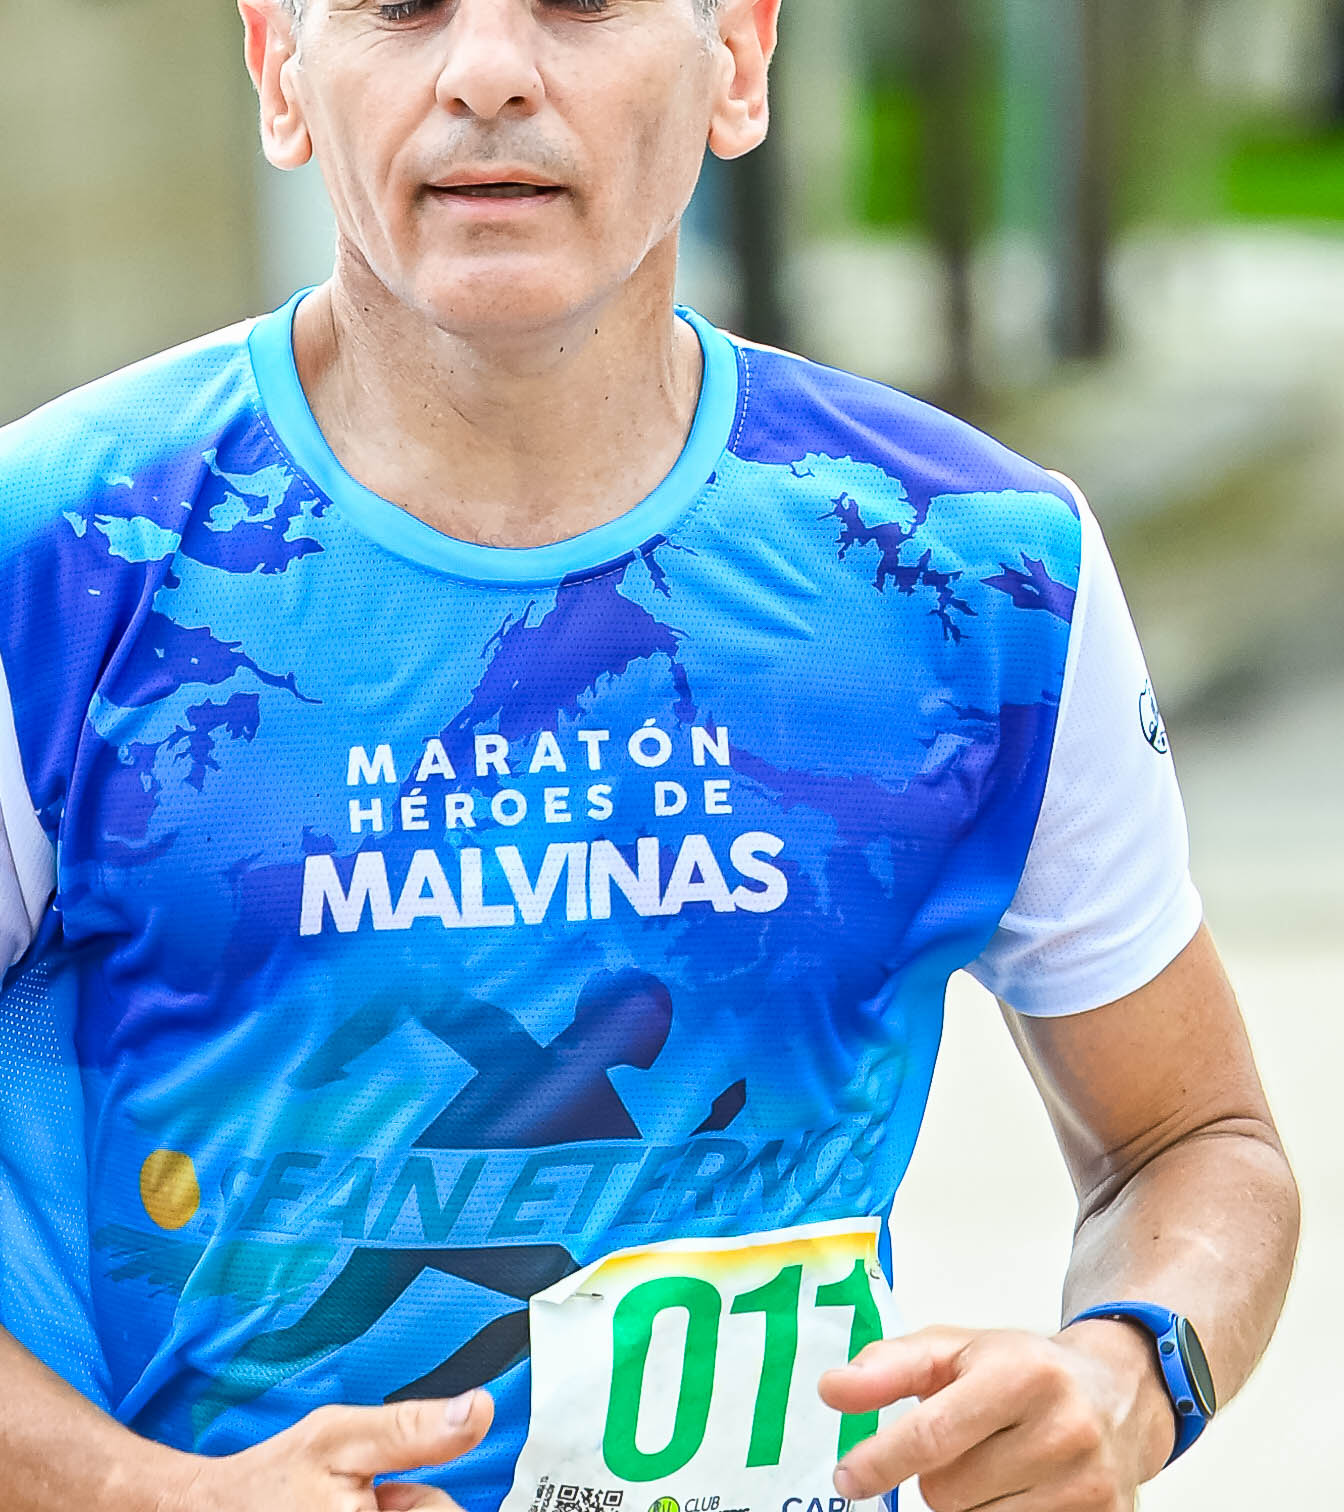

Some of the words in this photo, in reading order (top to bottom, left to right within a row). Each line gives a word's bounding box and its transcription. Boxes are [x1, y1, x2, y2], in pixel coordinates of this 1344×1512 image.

[346, 718, 731, 786] MARATÓN
[348, 784, 614, 833] HÉROES
[655, 779, 733, 818] DE
[299, 830, 789, 936] MALVINAS
